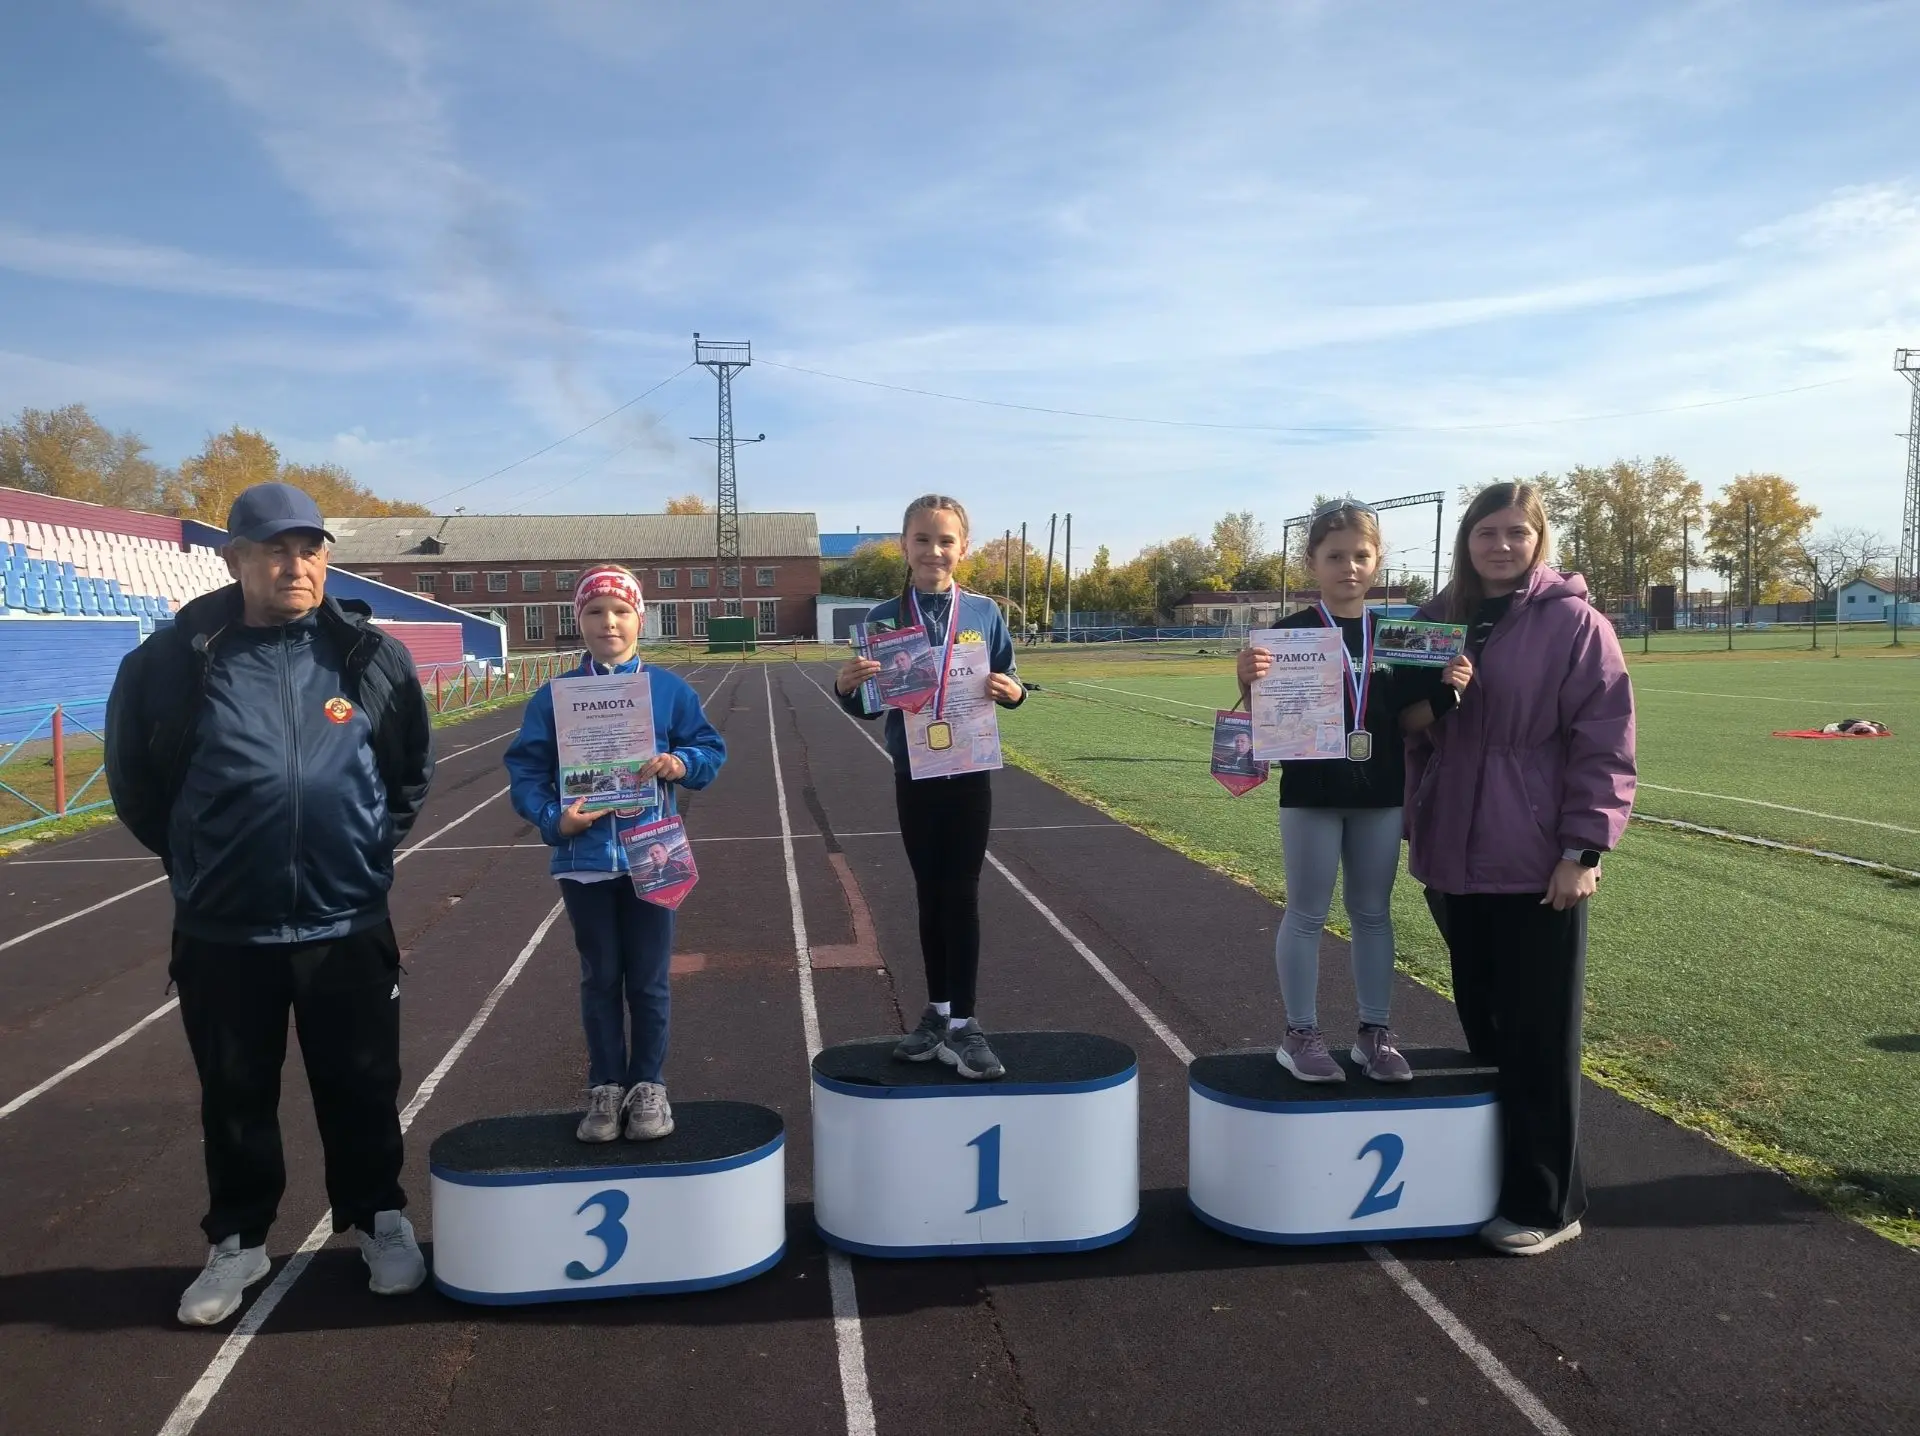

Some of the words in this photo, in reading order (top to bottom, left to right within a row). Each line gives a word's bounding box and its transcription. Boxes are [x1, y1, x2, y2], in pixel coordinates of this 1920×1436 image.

[573, 699, 634, 712] ГРАМОТА
[588, 793, 620, 802] АБИНСКИЙ
[966, 1124, 1008, 1213] 1
[1351, 1132, 1407, 1220] 2
[565, 1189, 632, 1281] 3
